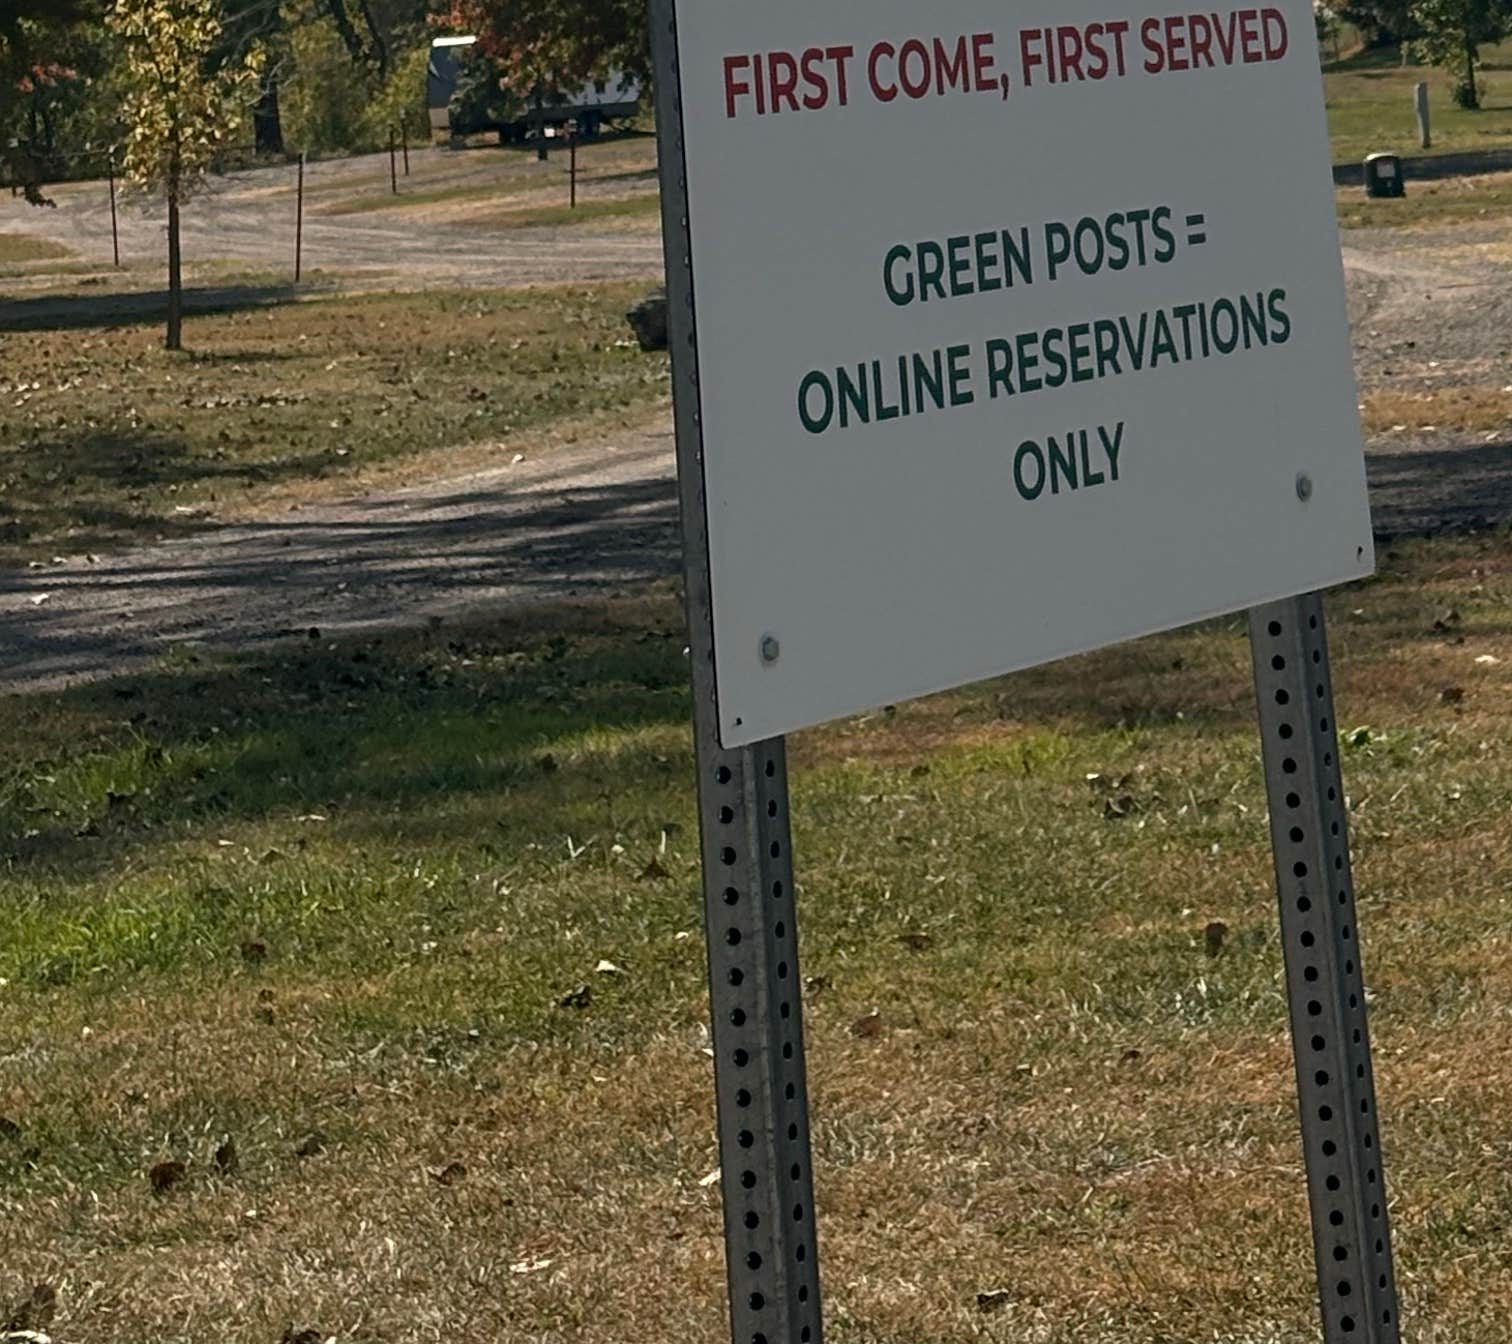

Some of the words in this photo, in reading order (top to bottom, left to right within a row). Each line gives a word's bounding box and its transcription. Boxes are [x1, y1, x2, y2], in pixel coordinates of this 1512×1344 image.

[723, 45, 853, 118] FIRST
[869, 32, 1010, 102] COME,
[1020, 21, 1129, 87] FIRST
[1141, 7, 1289, 72] SERVED
[884, 227, 1032, 307] GREEN
[1045, 206, 1175, 282] POSTS
[1187, 214, 1206, 246] =
[799, 343, 974, 435] ONLINE
[986, 288, 1291, 399] RESERVATIONS
[1013, 422, 1125, 501] ONLY
